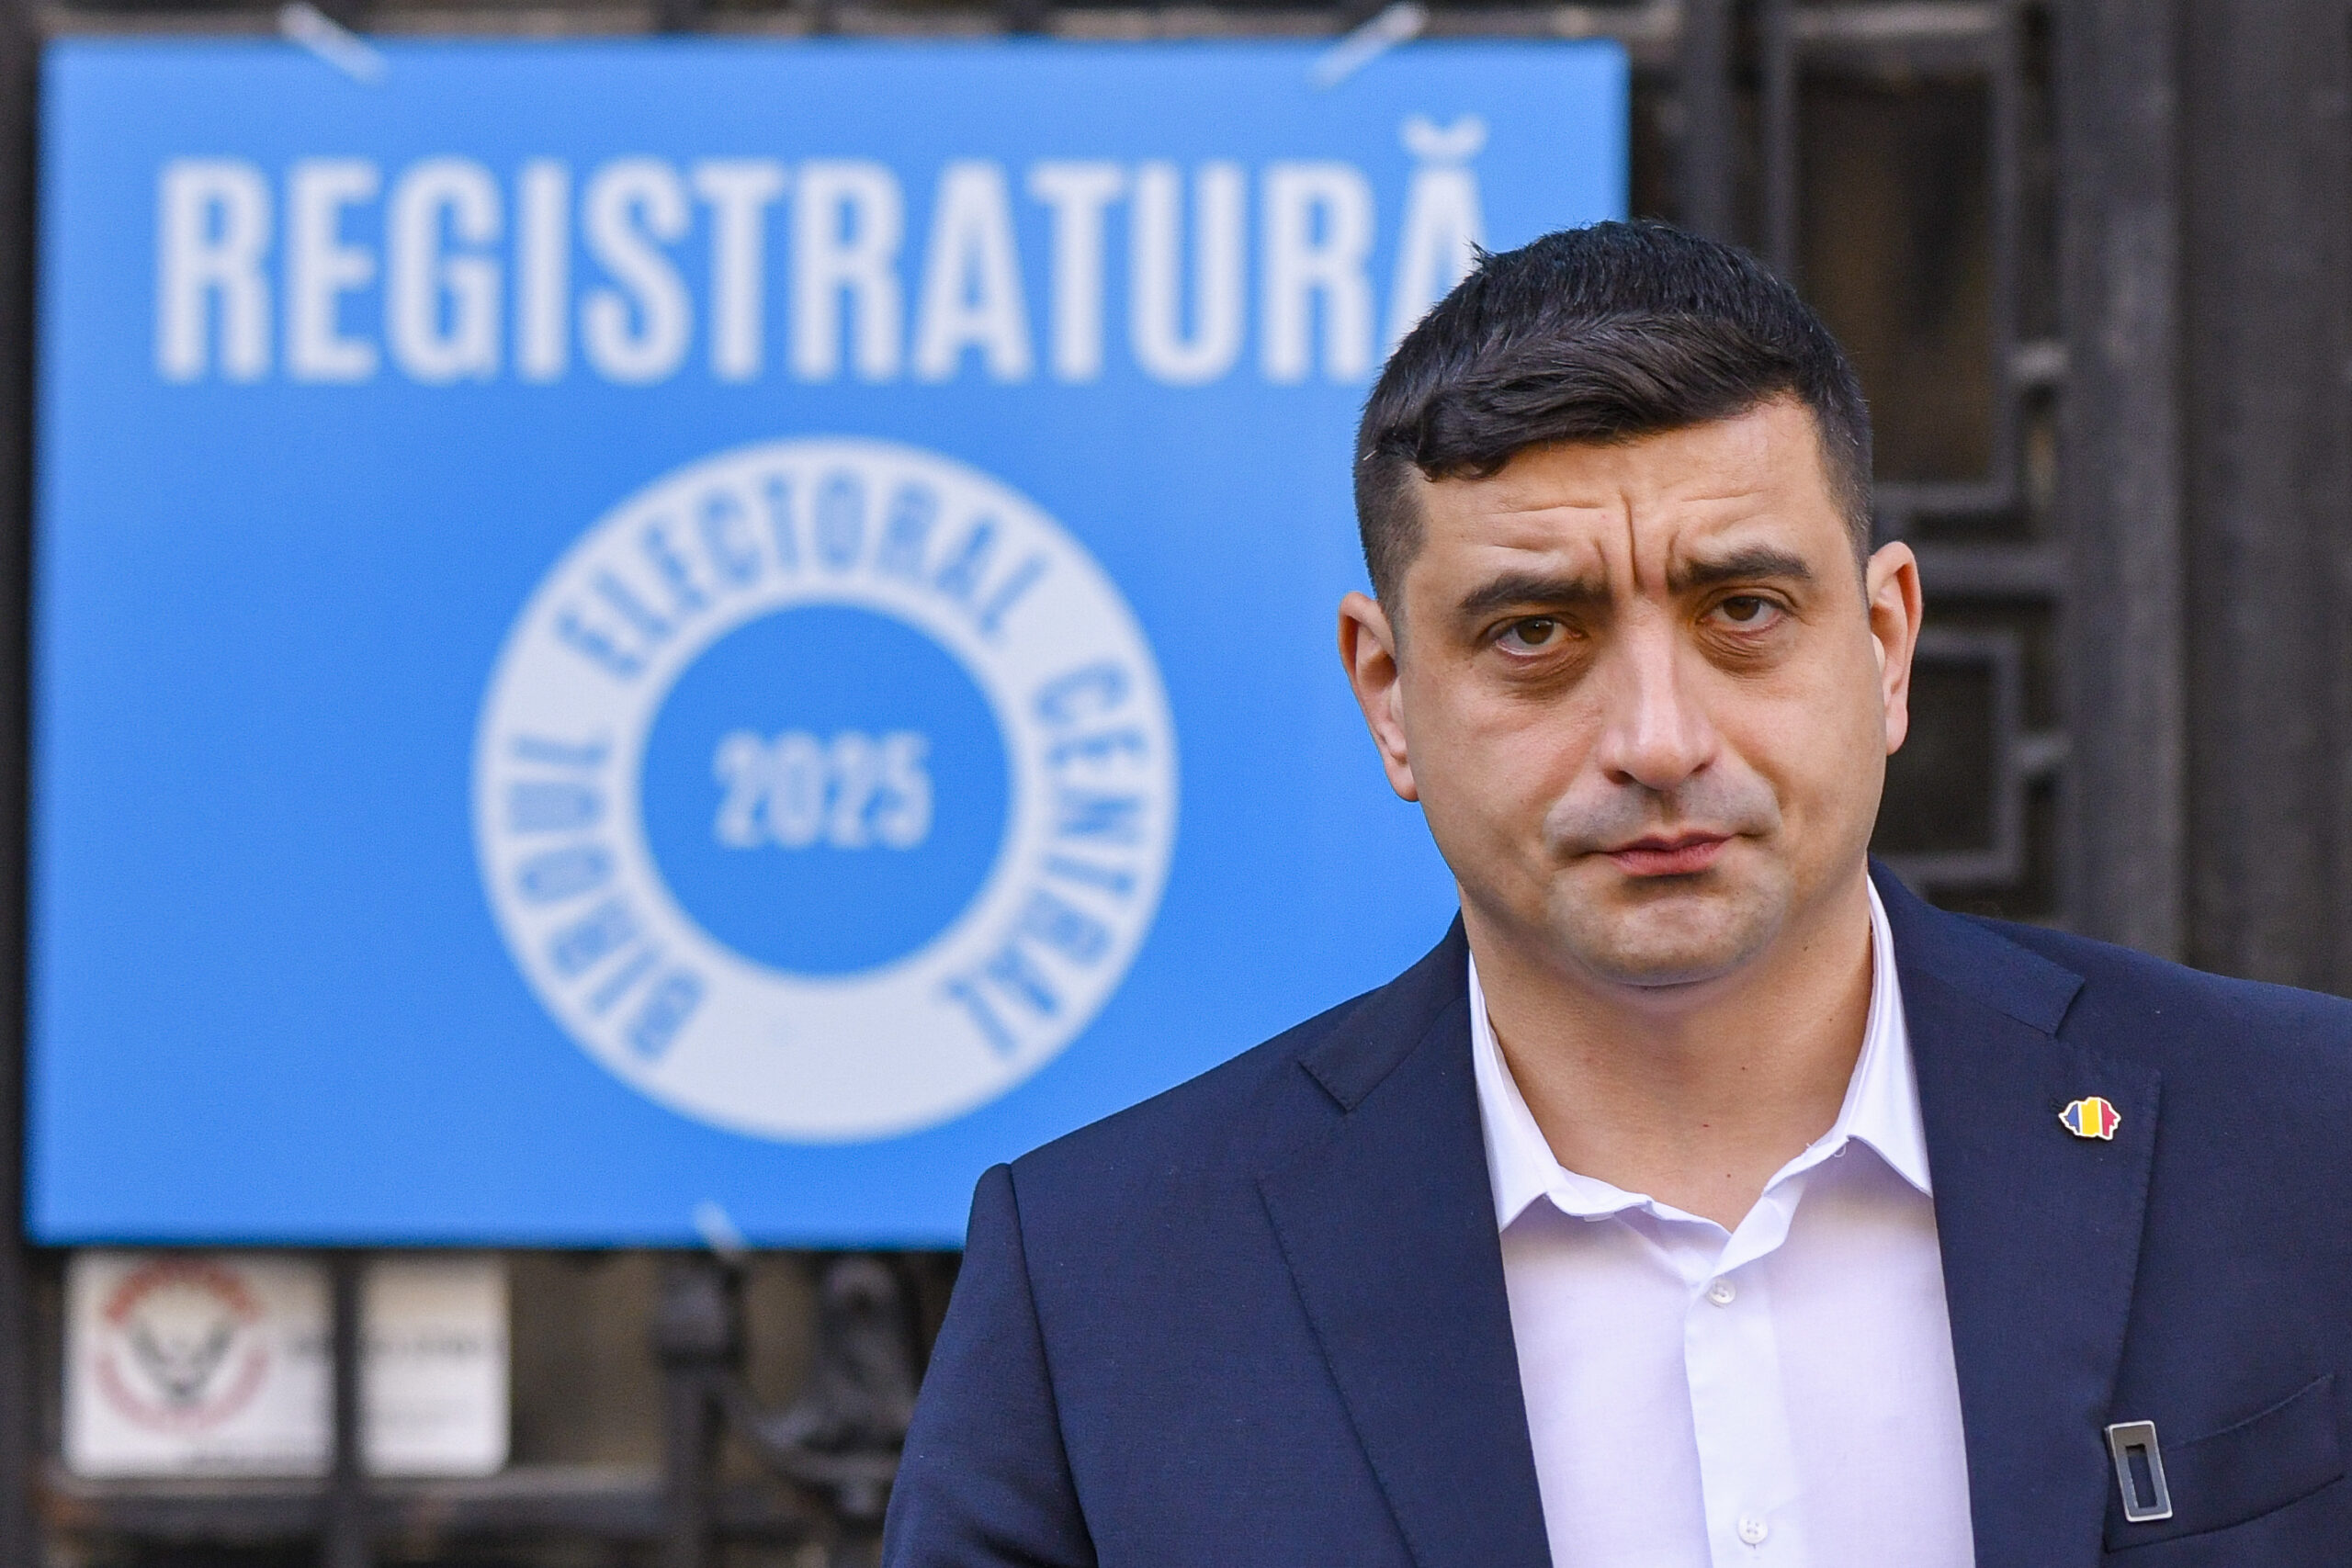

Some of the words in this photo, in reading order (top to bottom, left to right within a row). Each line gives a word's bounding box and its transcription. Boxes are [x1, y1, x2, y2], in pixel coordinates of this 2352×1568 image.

[157, 116, 1488, 382] REGISTRATURĂ
[556, 468, 1051, 681] ELECTORAL
[507, 733, 706, 1064] BIROUL
[713, 731, 933, 848] 2025
[943, 658, 1148, 1060] CENTRAL
